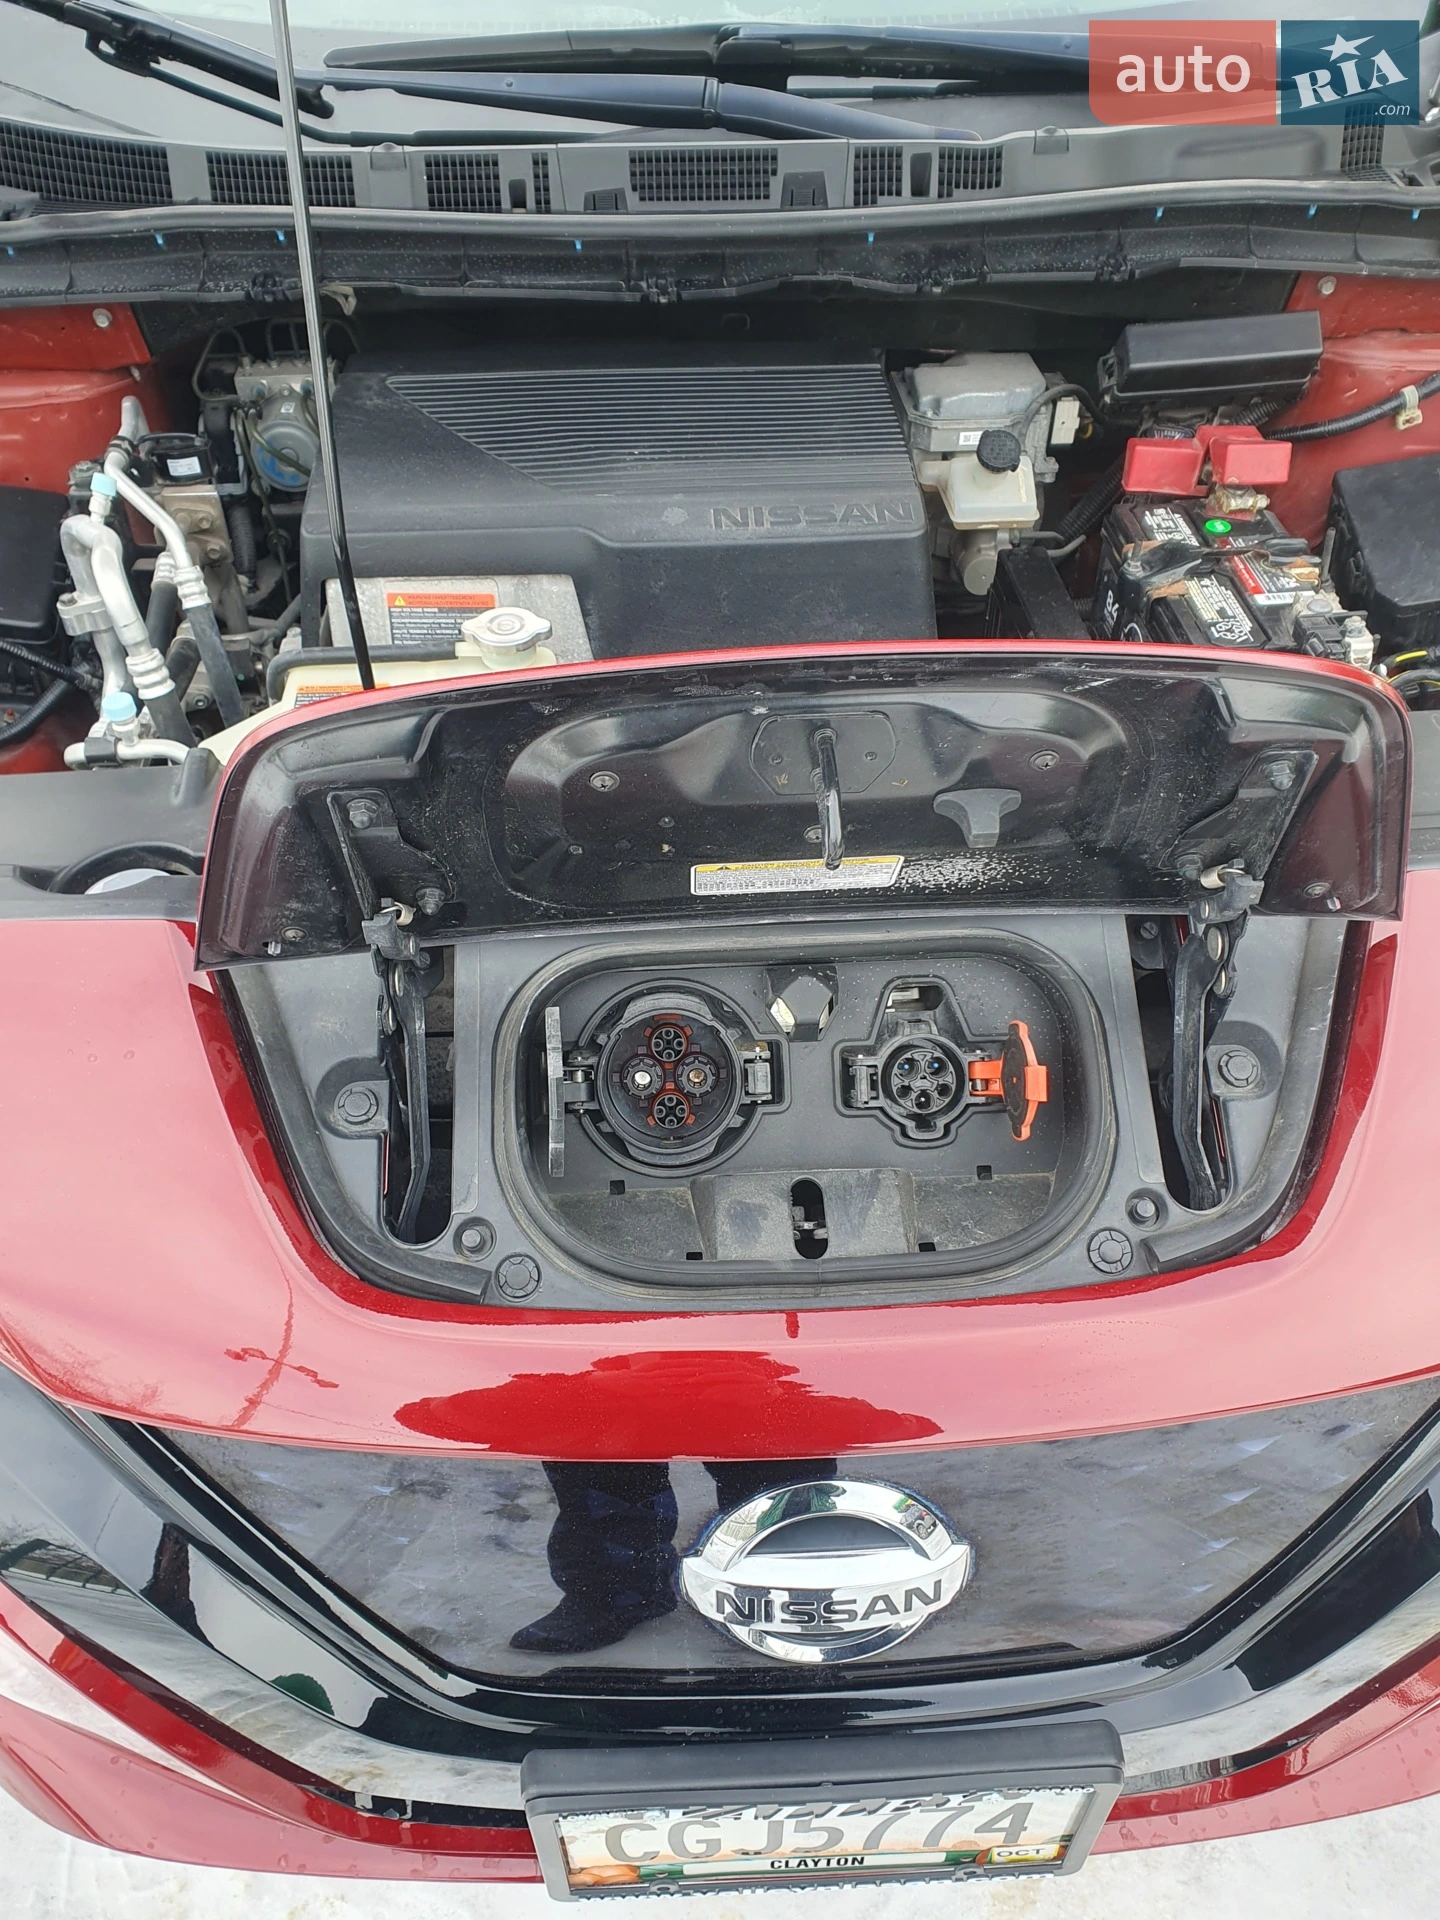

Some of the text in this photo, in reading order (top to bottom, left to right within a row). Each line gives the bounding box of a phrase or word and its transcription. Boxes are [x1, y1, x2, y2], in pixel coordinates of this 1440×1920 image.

[711, 502, 915, 530] NISSAN
[715, 1578, 943, 1626] NISSAN
[605, 1802, 1034, 1863] CGJ5774
[769, 1855, 866, 1870] CLAYTON
[996, 1847, 1046, 1858] OCT
